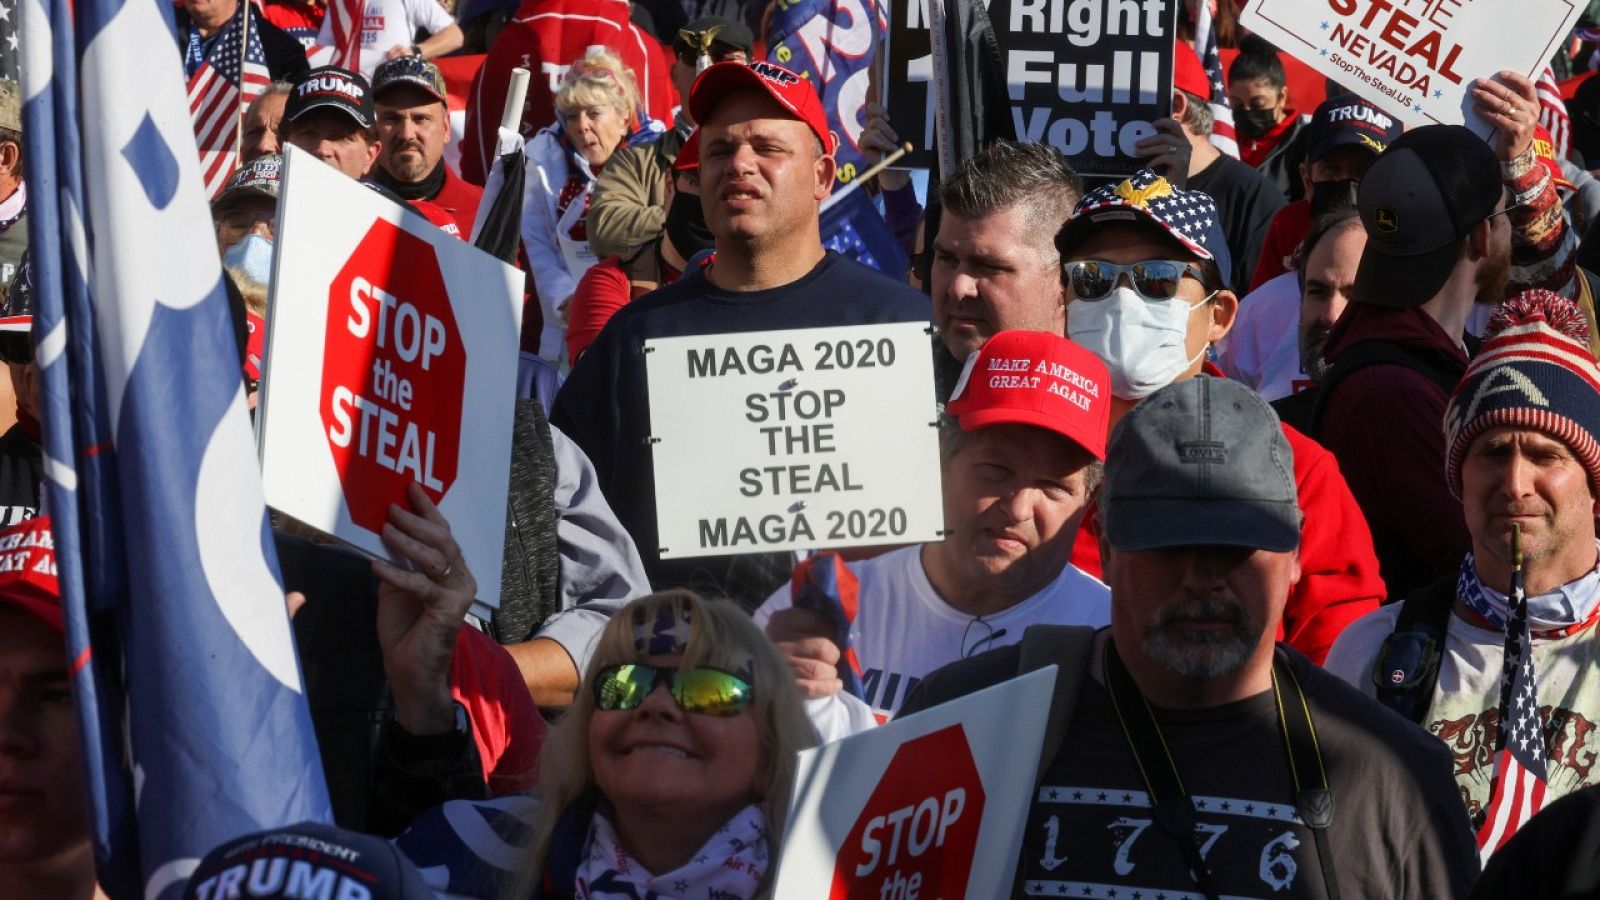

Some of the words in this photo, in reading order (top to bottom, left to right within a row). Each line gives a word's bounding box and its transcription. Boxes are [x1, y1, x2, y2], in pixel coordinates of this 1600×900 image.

[1009, 0, 1165, 46] Right
[1007, 50, 1158, 105] Full
[1329, 22, 1431, 98] NEVADA
[297, 76, 364, 99] TRUMP
[1011, 106, 1159, 157] Vote
[1328, 105, 1393, 130] TRUMP
[347, 276, 446, 371] STOP
[687, 343, 804, 378] MAGA
[814, 338, 896, 371] 2020
[988, 358, 1031, 372] MAKE
[1034, 359, 1099, 398] AMERICA
[372, 358, 413, 410] the
[989, 375, 1041, 389] GREAT
[1047, 381, 1092, 412] AGAIN
[745, 389, 846, 422] STOP
[329, 385, 444, 493] STEAL
[759, 424, 836, 456] THE
[739, 462, 864, 497] STEAL
[698, 513, 816, 548] MAGA
[826, 507, 907, 540] 2020
[855, 787, 967, 877] STOP
[195, 856, 374, 900] TRUMP
[879, 870, 923, 900] the
